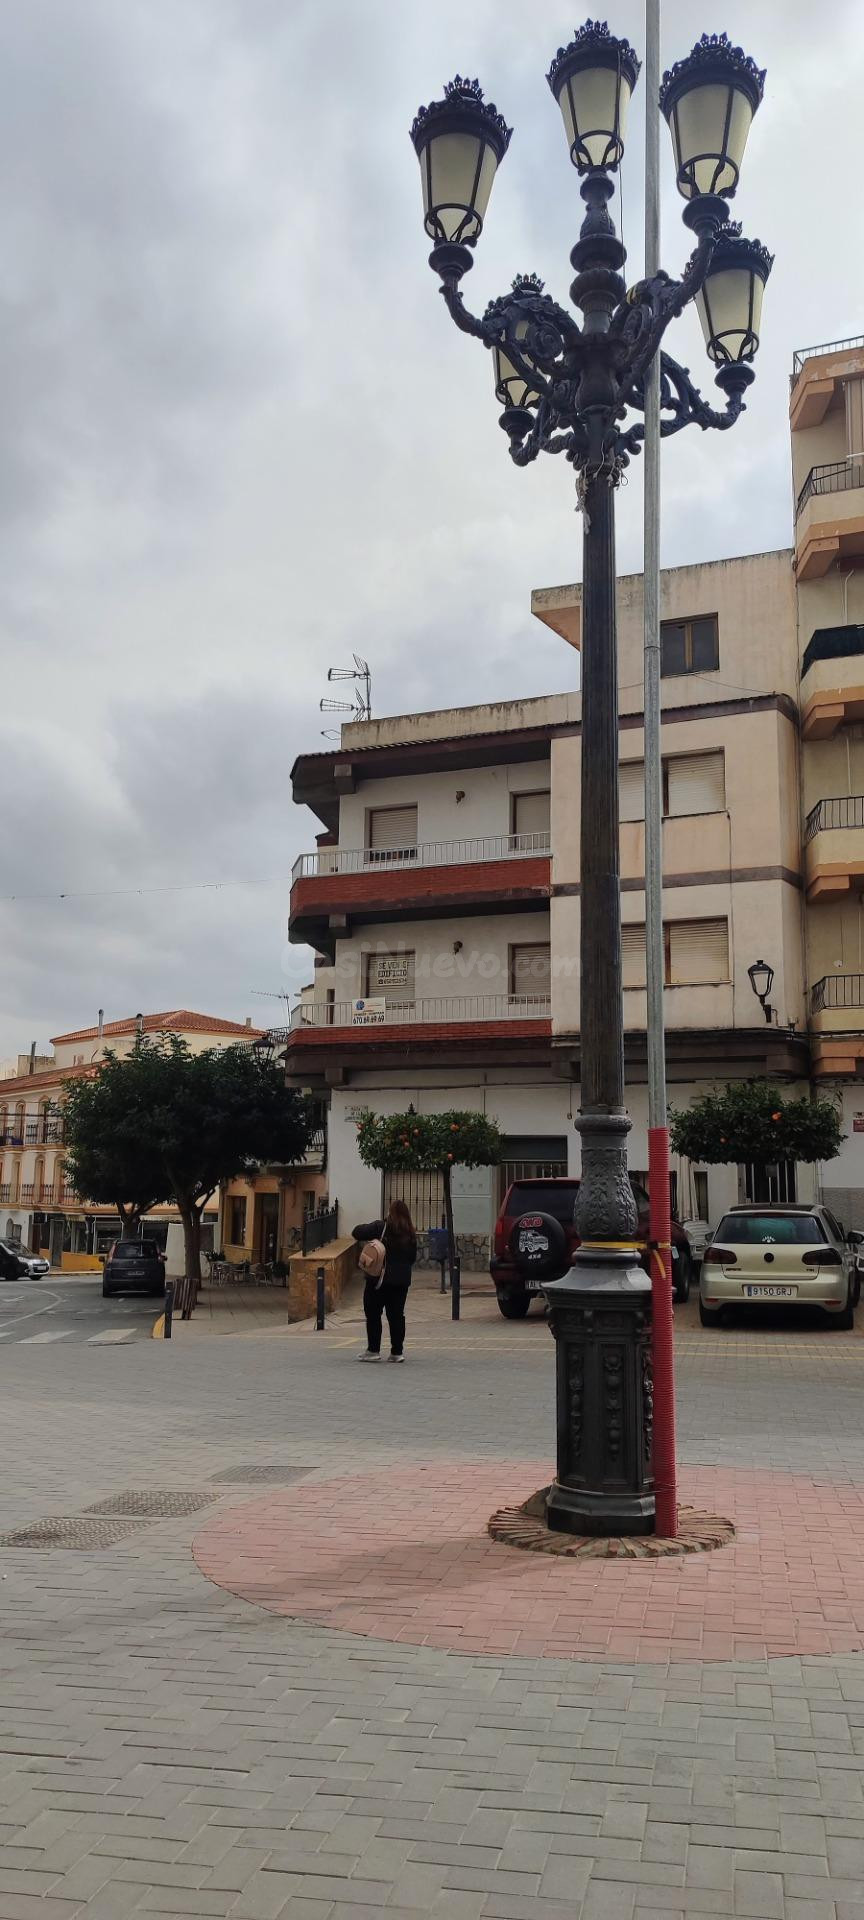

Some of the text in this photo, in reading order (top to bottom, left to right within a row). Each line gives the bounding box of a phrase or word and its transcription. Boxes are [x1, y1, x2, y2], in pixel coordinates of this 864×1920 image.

[378, 969, 406, 977] EDIFICIO
[519, 1217, 543, 1228] 4WD
[754, 1288, 792, 1296] 9150 GRJ
